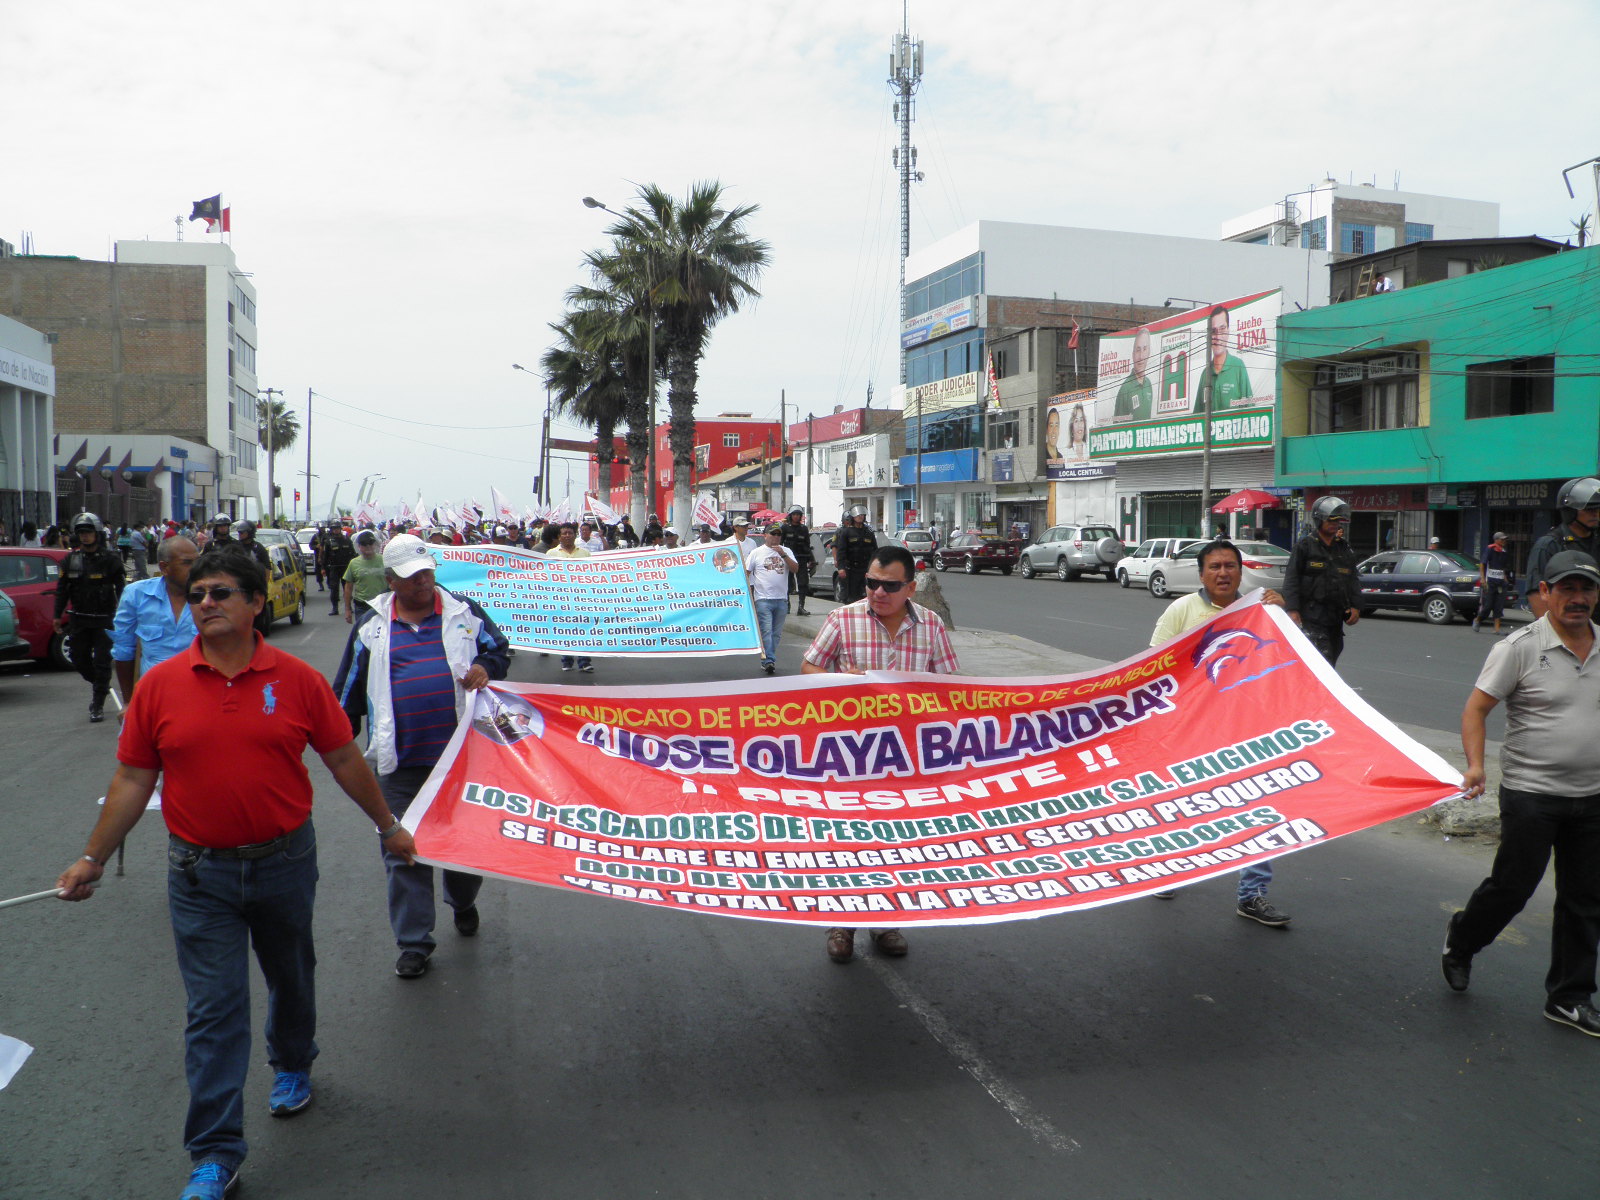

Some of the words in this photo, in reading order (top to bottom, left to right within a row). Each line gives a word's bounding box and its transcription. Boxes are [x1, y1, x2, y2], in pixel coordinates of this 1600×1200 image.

[1237, 316, 1262, 331] Lucho
[1166, 334, 1185, 344] PARTIDO
[1237, 328, 1267, 350] LUNA
[1100, 351, 1118, 362] Lucho
[12, 359, 19, 378] de
[22, 362, 27, 380] la
[29, 364, 49, 387] Nación
[1099, 359, 1130, 377] DENEGRI
[915, 382, 938, 398] PODER
[940, 374, 976, 392] JUDICIAL
[1159, 400, 1187, 410] PERUANO
[840, 420, 856, 435] Claro
[1090, 430, 1134, 453] PARTIDO
[1136, 422, 1204, 448] HUMANISTA
[1211, 415, 1270, 441] PERUANO
[1077, 468, 1104, 476] CENTRAL
[1485, 483, 1548, 499] ABOGADOS
[442, 550, 505, 567] SINDICATO
[508, 555, 545, 571] ÚNICO
[548, 563, 563, 572] DE
[566, 562, 634, 573] CAPITANES,
[636, 553, 696, 570] PATRONES
[697, 552, 706, 563] Y
[487, 569, 548, 582] OFICIALES
[551, 573, 568, 583] DE
[570, 574, 609, 584] PESCA
[610, 573, 633, 584] DEL
[635, 570, 667, 582] PERÚ
[489, 581, 510, 589] Por
[513, 582, 524, 590] la
[528, 583, 587, 594] Liberación
[591, 586, 618, 594] Total
[622, 585, 638, 594] del
[642, 582, 674, 592] C.T.S.
[487, 592, 506, 601] por
[510, 591, 517, 599] 5
[521, 592, 549, 601] años
[552, 594, 570, 602] del
[574, 595, 632, 604] descuento
[652, 593, 664, 601] la
[667, 592, 686, 600] 5ta
[689, 588, 746, 599] categoría.
[493, 600, 538, 610] General
[560, 603, 571, 611] el
[613, 604, 665, 614] pesquero
[669, 599, 743, 611] (Industriales,
[511, 612, 548, 622] menor
[552, 614, 590, 624] escala
[593, 616, 600, 625] y
[603, 613, 663, 624] artesanal)
[516, 624, 531, 634] de
[534, 625, 549, 635] un
[552, 626, 585, 636] fondo
[589, 627, 604, 636] de
[607, 623, 682, 636] contingencia
[685, 622, 750, 633] ecónomica.
[534, 637, 603, 648] emergencia
[606, 637, 617, 646] el
[620, 637, 657, 647] sector
[660, 636, 717, 647] Pesquero.
[561, 705, 692, 728] SINDICATO
[700, 707, 732, 729] DE
[739, 694, 902, 728] PESCADORES
[908, 693, 948, 715] DEL
[949, 690, 1035, 712] PUERTO
[1039, 688, 1070, 703] DE
[1073, 649, 1178, 695] CHIMBOTE
[744, 727, 913, 781] OLAYA
[463, 782, 531, 816] LOS
[533, 799, 759, 842] PESCADORES
[761, 813, 809, 842] DE
[809, 812, 983, 843] PESQUERA
[979, 786, 1115, 828] HAYDUK
[1108, 769, 1176, 802] S.A.
[1167, 720, 1335, 784] EXIGIMOS:
[739, 761, 1066, 810] PRESENTE
[1077, 744, 1120, 773] !!
[501, 820, 547, 845] SE
[552, 832, 708, 866] DECLARE
[714, 849, 760, 868] EN
[765, 839, 987, 868] EMERGENCIA
[986, 832, 1028, 854] EL
[1027, 808, 1160, 848] SECTOR
[1155, 760, 1323, 823] PESQUERO
[576, 857, 684, 885] BONO
[689, 868, 739, 889] DE
[740, 870, 897, 890] VÍVERES
[895, 861, 998, 886] PARA
[993, 853, 1064, 878] LOS
[1060, 806, 1285, 870] PESCADORES
[561, 875, 666, 901] VEDA
[667, 889, 787, 911] TOTAL
[793, 892, 899, 912] PARA
[895, 890, 948, 911] LA
[947, 877, 1073, 908] PESCA
[1067, 869, 1121, 893] DE
[1116, 818, 1328, 883] ANCHOVETA
